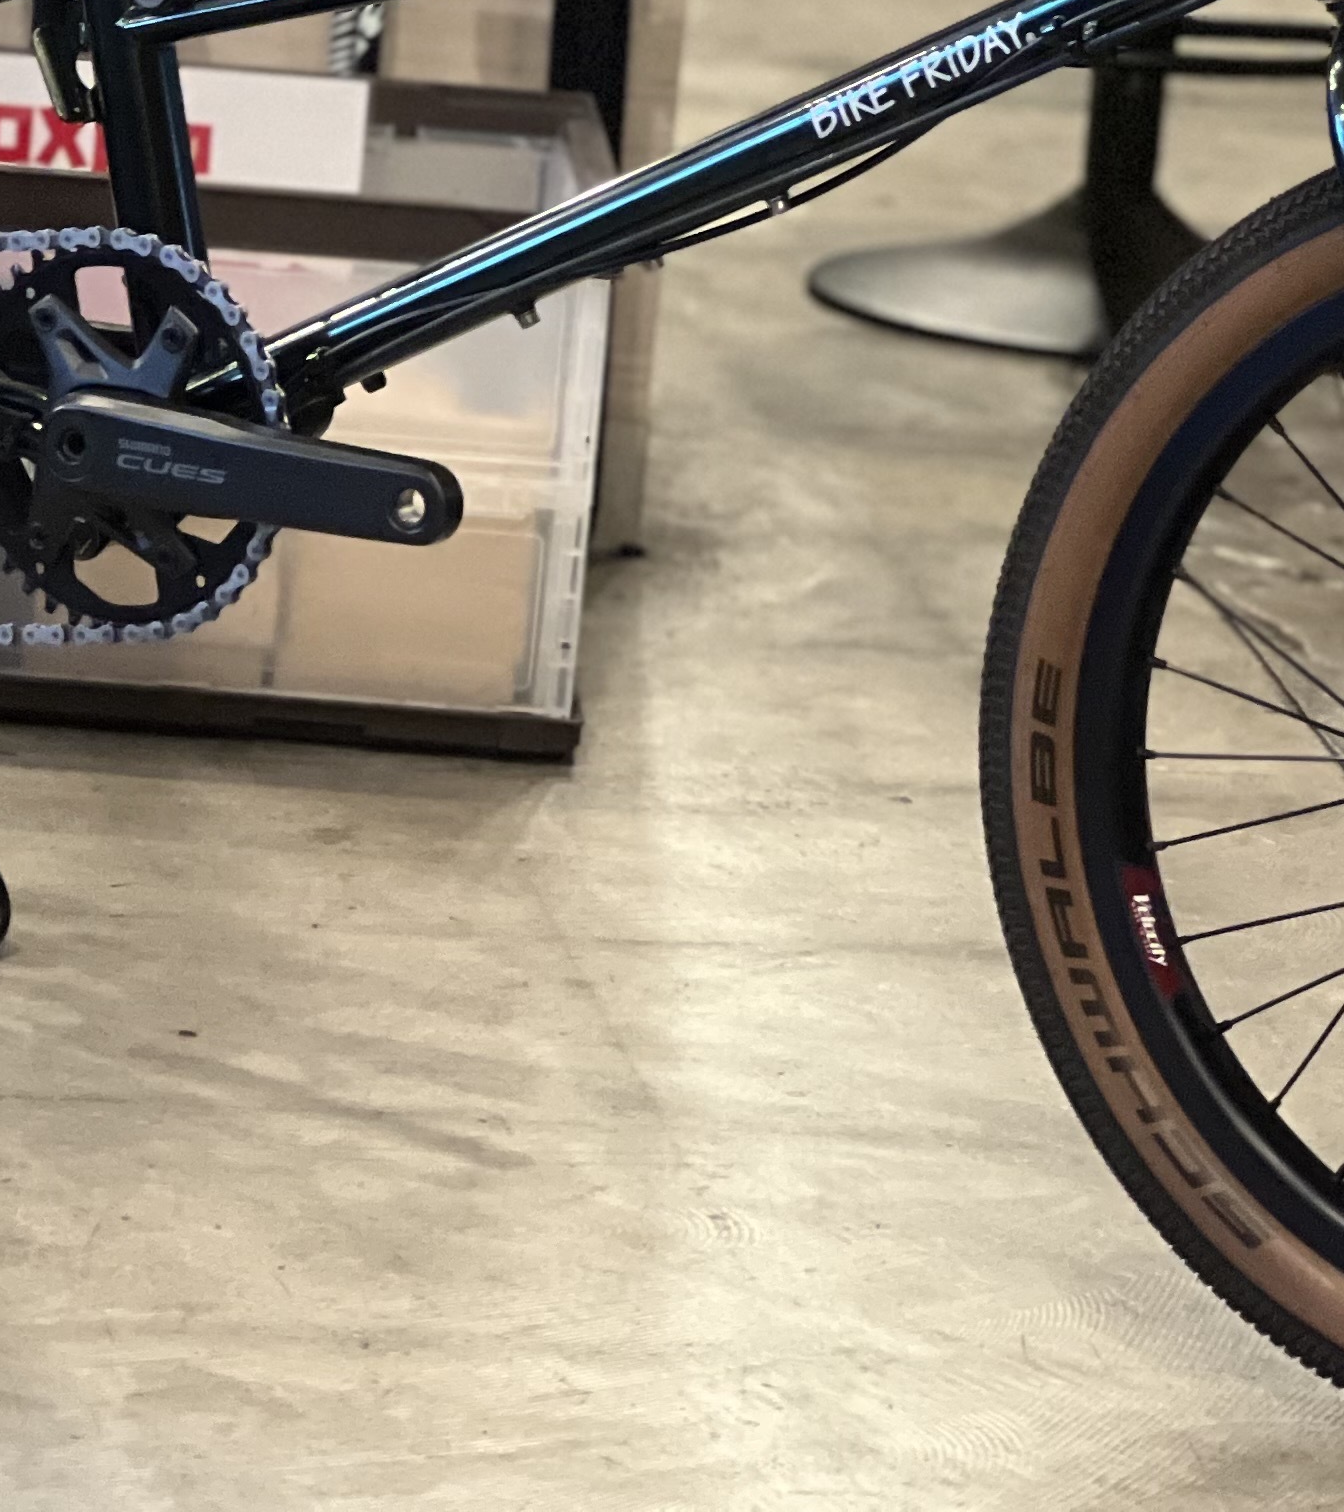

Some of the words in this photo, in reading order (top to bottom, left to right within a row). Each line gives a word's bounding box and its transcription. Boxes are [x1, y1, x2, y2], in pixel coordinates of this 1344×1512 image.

[809, 74, 896, 139] BIKE
[116, 453, 226, 485] CUES
[1030, 656, 1275, 1250] SCHWALBE
[1132, 894, 1168, 967] Velocity
